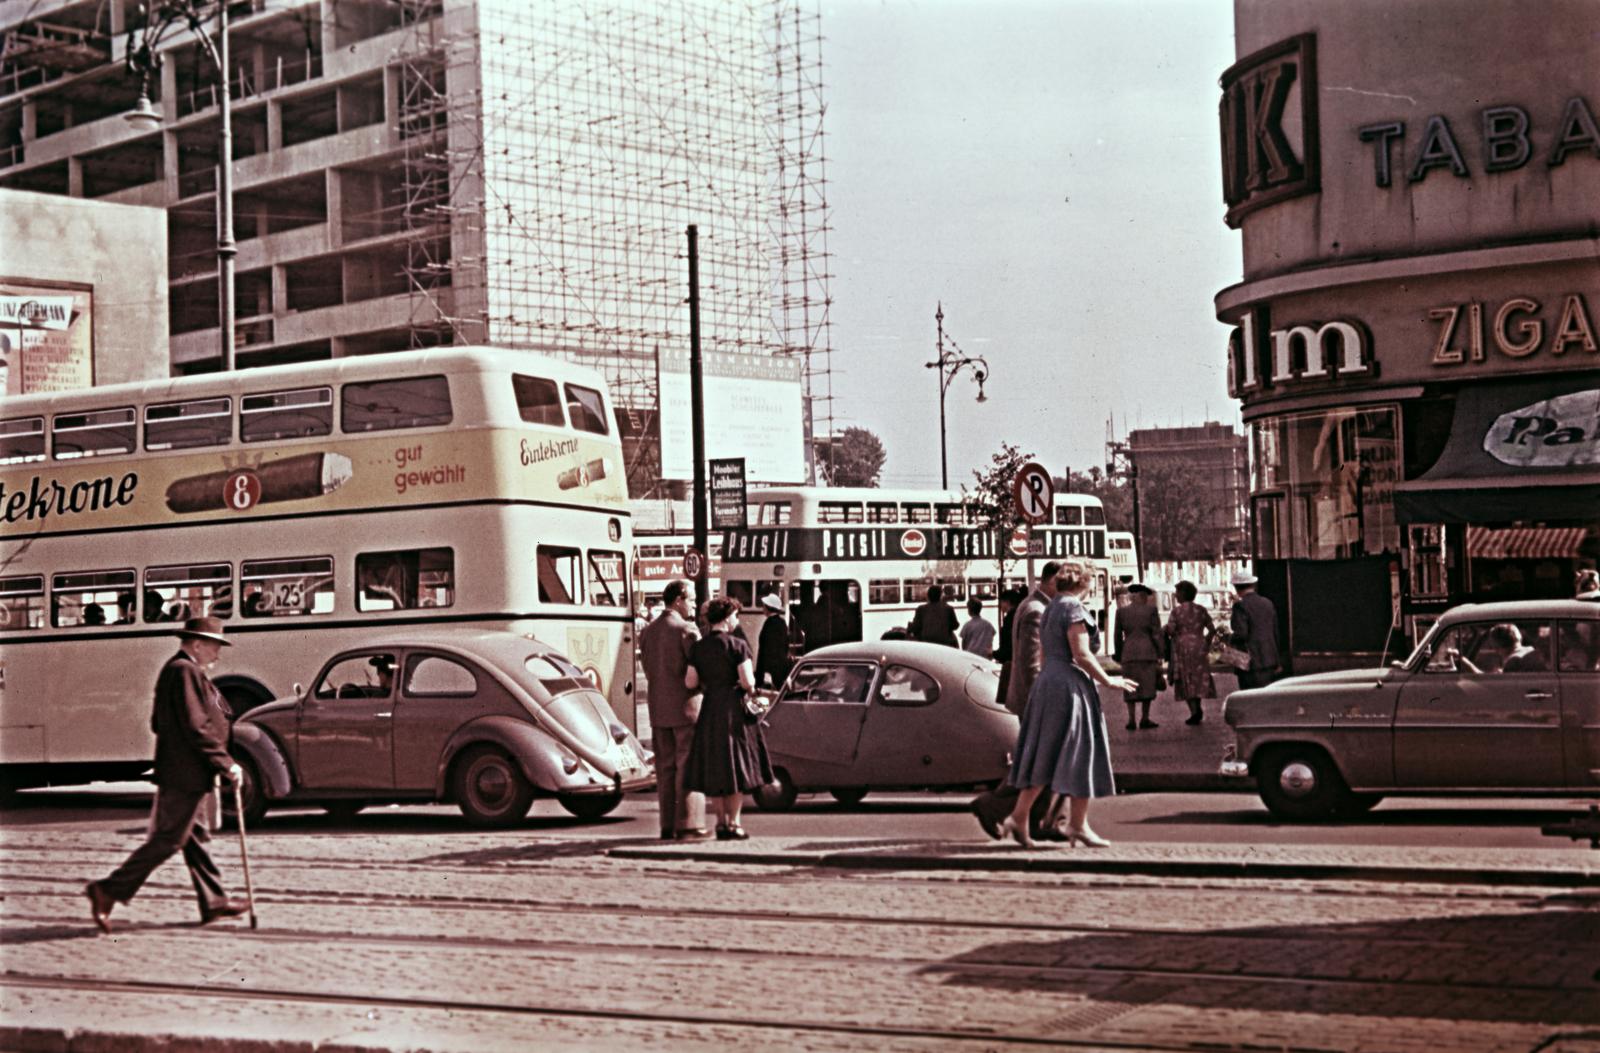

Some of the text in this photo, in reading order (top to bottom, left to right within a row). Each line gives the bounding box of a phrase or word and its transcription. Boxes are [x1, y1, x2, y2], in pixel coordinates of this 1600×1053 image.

[1429, 294, 1598, 365] ZIGA
[520, 437, 579, 466] Erntekrone
[394, 464, 467, 494] gewählt
[1030, 475, 1043, 513] P
[728, 531, 789, 558] Persil
[823, 529, 887, 558] Persil
[941, 529, 997, 556] Persil
[1045, 529, 1095, 556] Persil
